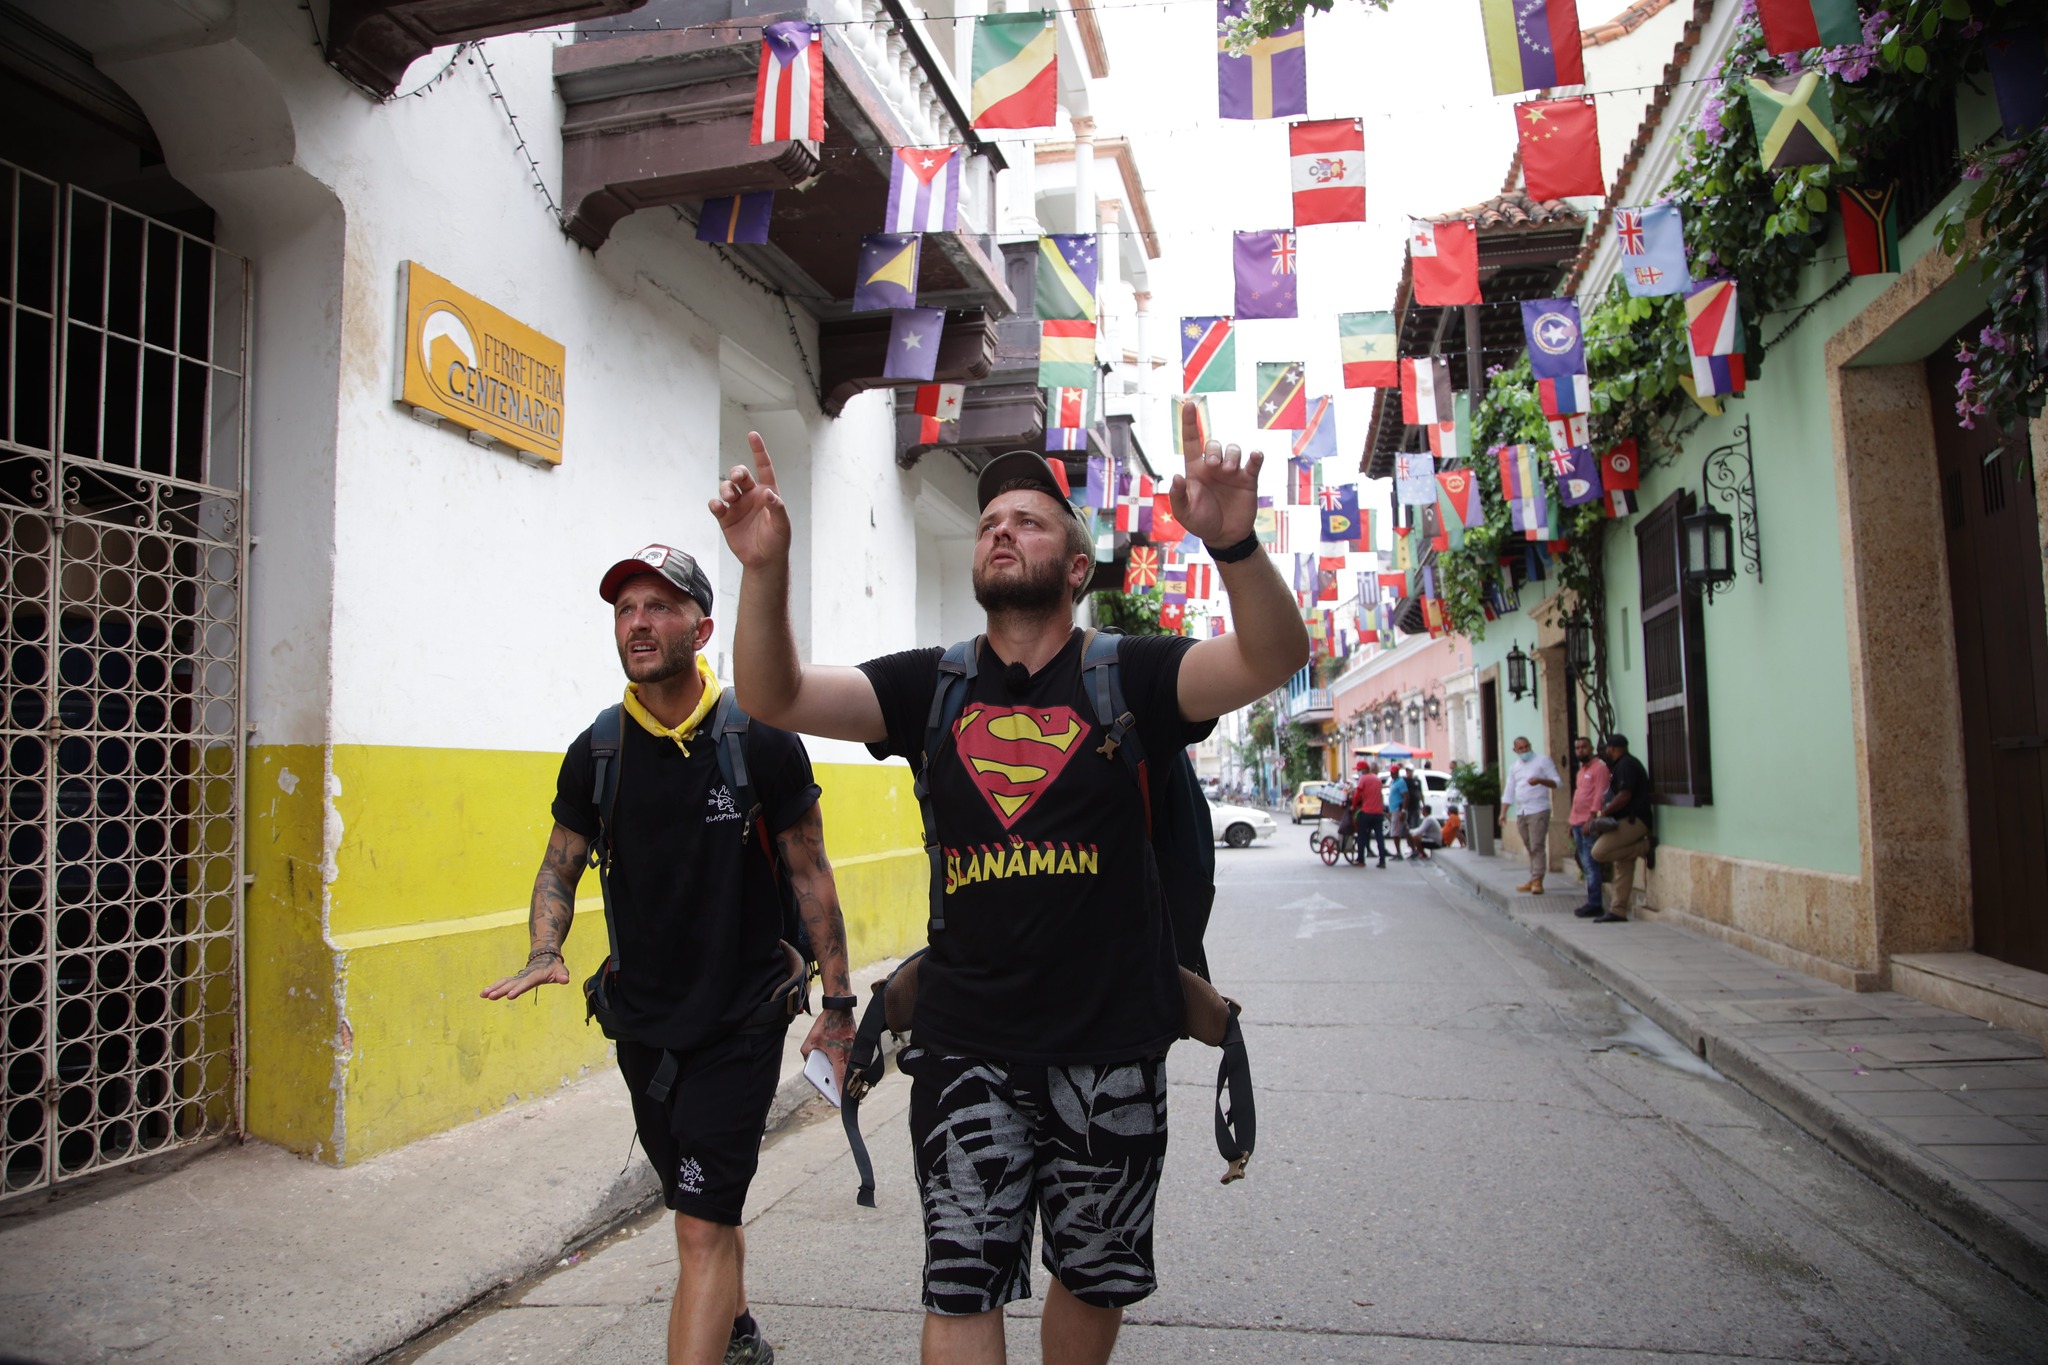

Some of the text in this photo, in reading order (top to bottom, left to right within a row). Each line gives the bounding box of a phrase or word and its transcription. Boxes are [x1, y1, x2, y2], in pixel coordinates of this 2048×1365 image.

[447, 360, 561, 438] CENTENARIO
[483, 332, 565, 406] FERRETERÍA
[705, 812, 742, 823] BLASPHEM
